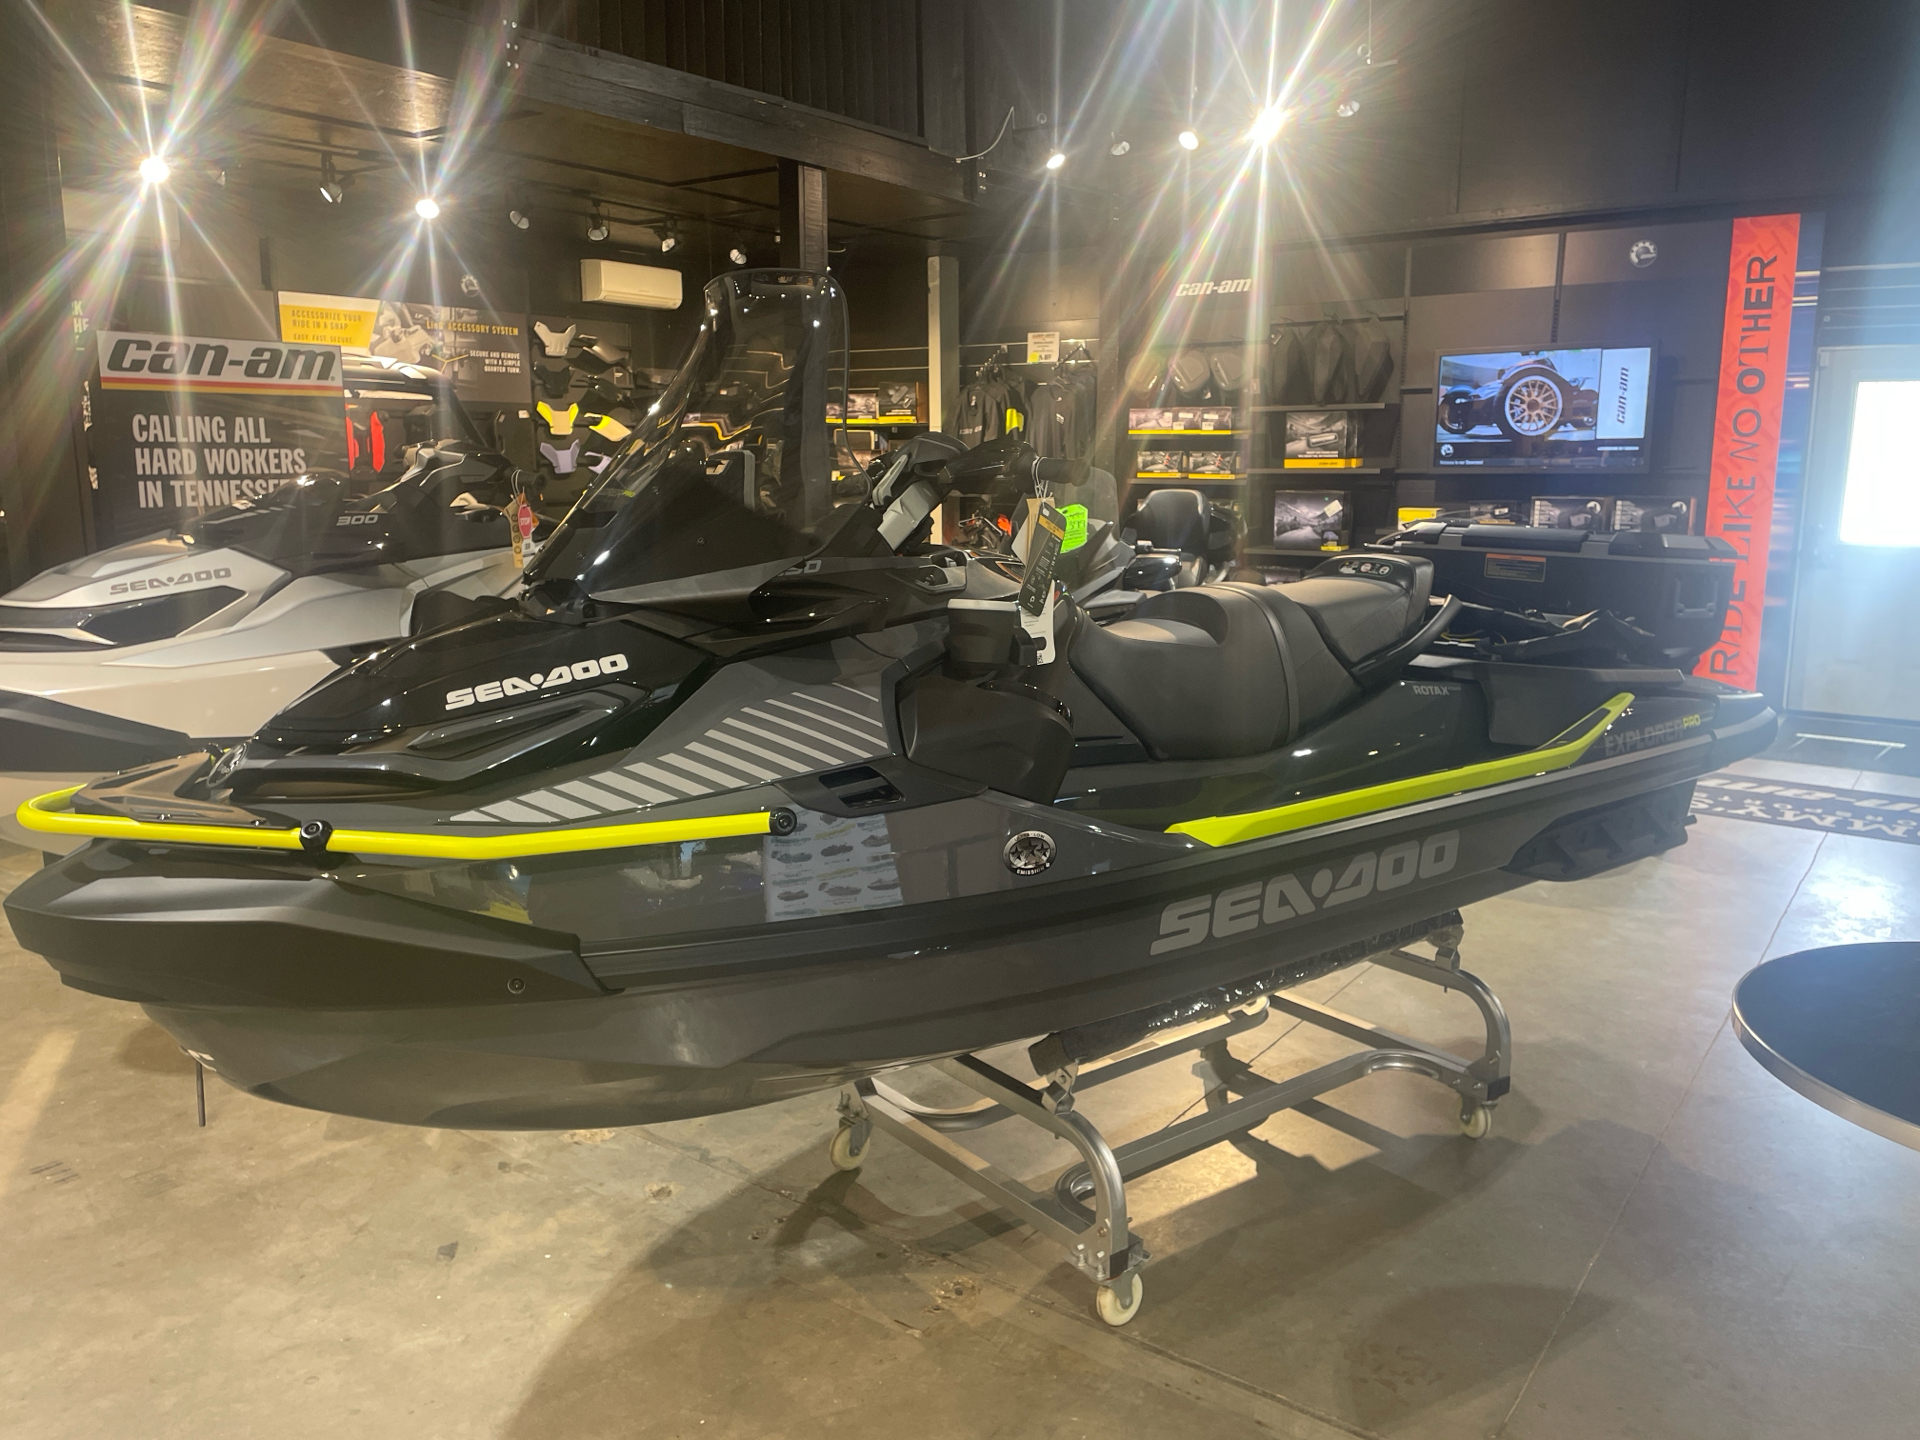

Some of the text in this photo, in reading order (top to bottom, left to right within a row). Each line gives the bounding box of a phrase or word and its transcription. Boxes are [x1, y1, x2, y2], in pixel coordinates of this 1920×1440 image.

[1175, 278, 1252, 296] can-am
[291, 309, 362, 322] ACCESSORIZE YOUR
[292, 319, 311, 328] RIDE
[312, 320, 321, 329] IN
[323, 321, 329, 330] A
[446, 321, 490, 334] ACCESSORY
[491, 325, 519, 336] SYSTEM
[1736, 254, 1778, 395] OTHER
[107, 338, 335, 381] can-am
[1616, 367, 1629, 424] can-am
[132, 413, 272, 444] CALLING ALL
[1730, 408, 1762, 462] NO
[134, 447, 307, 476] HARD WORKERS
[138, 480, 164, 508] IN
[336, 514, 379, 526] 300
[1722, 476, 1756, 563] LIKE
[1412, 685, 1450, 695] ROTAX
[1604, 713, 1701, 756] EXPLORER PRO
[1689, 795, 1920, 838] MMY'S
